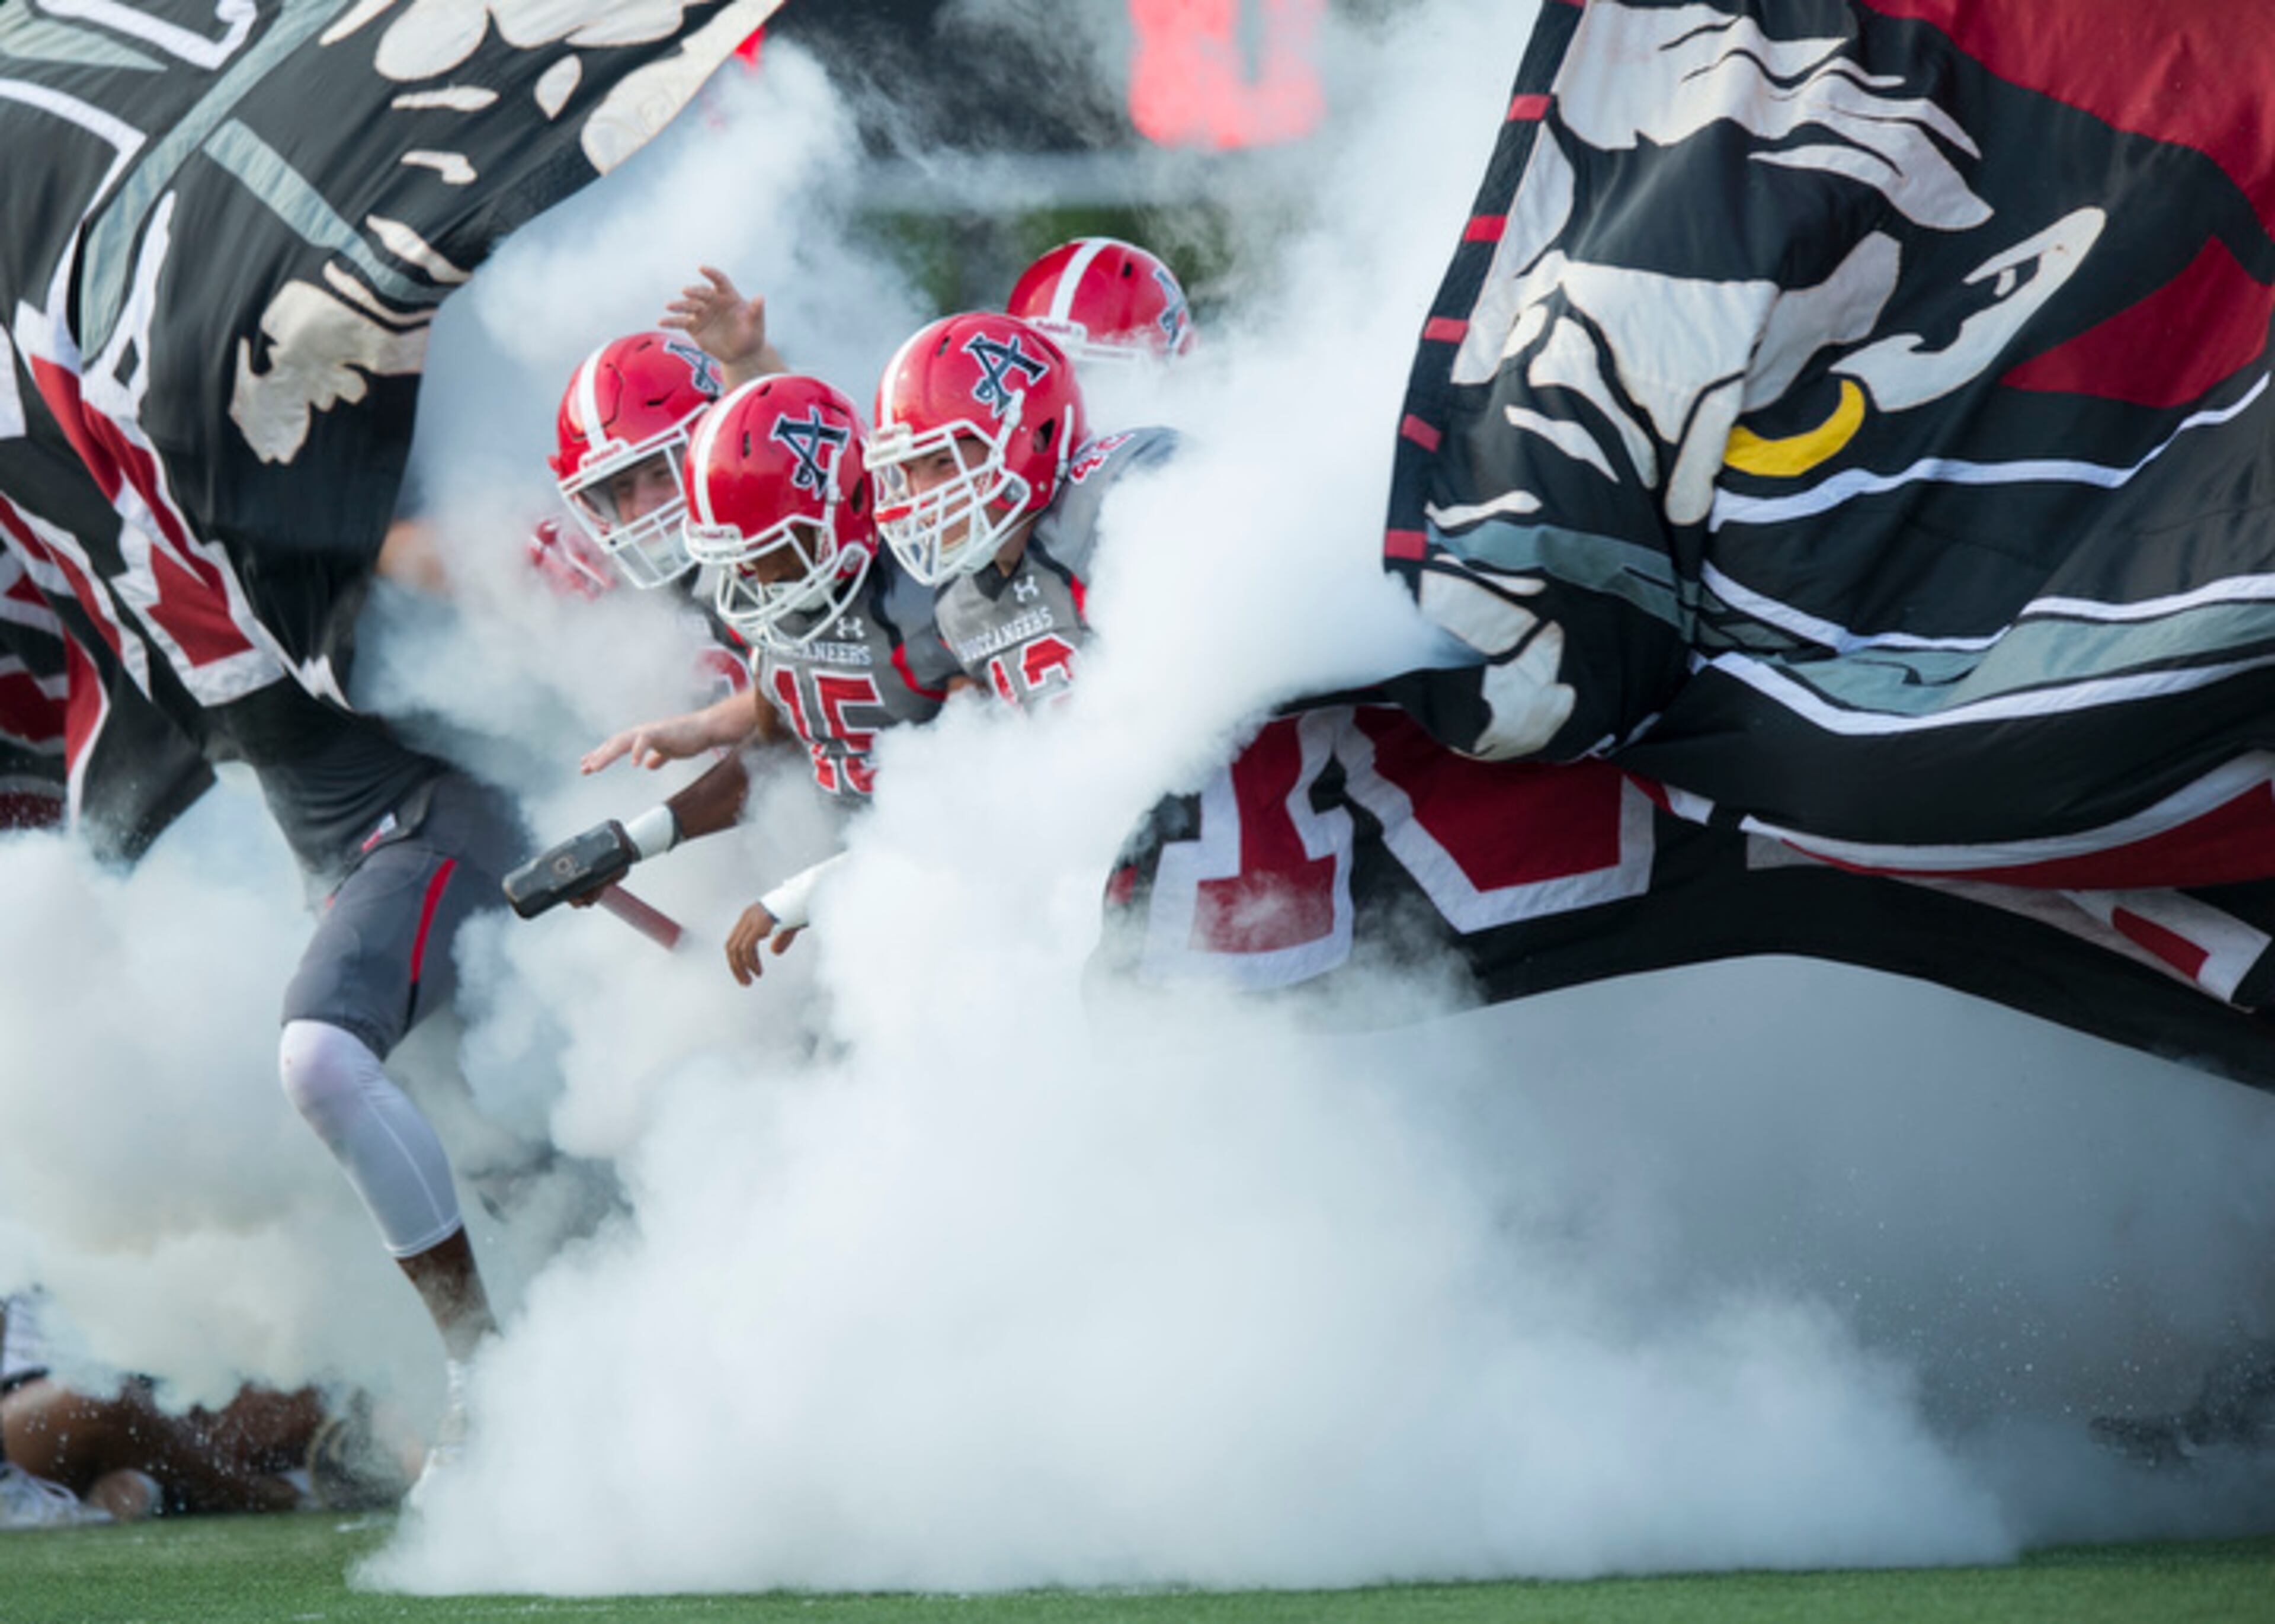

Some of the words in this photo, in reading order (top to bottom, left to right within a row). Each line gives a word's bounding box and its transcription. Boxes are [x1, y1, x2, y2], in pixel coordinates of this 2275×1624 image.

[962, 332, 1049, 419] A
[771, 405, 850, 501] A
[773, 664, 885, 795] 15
